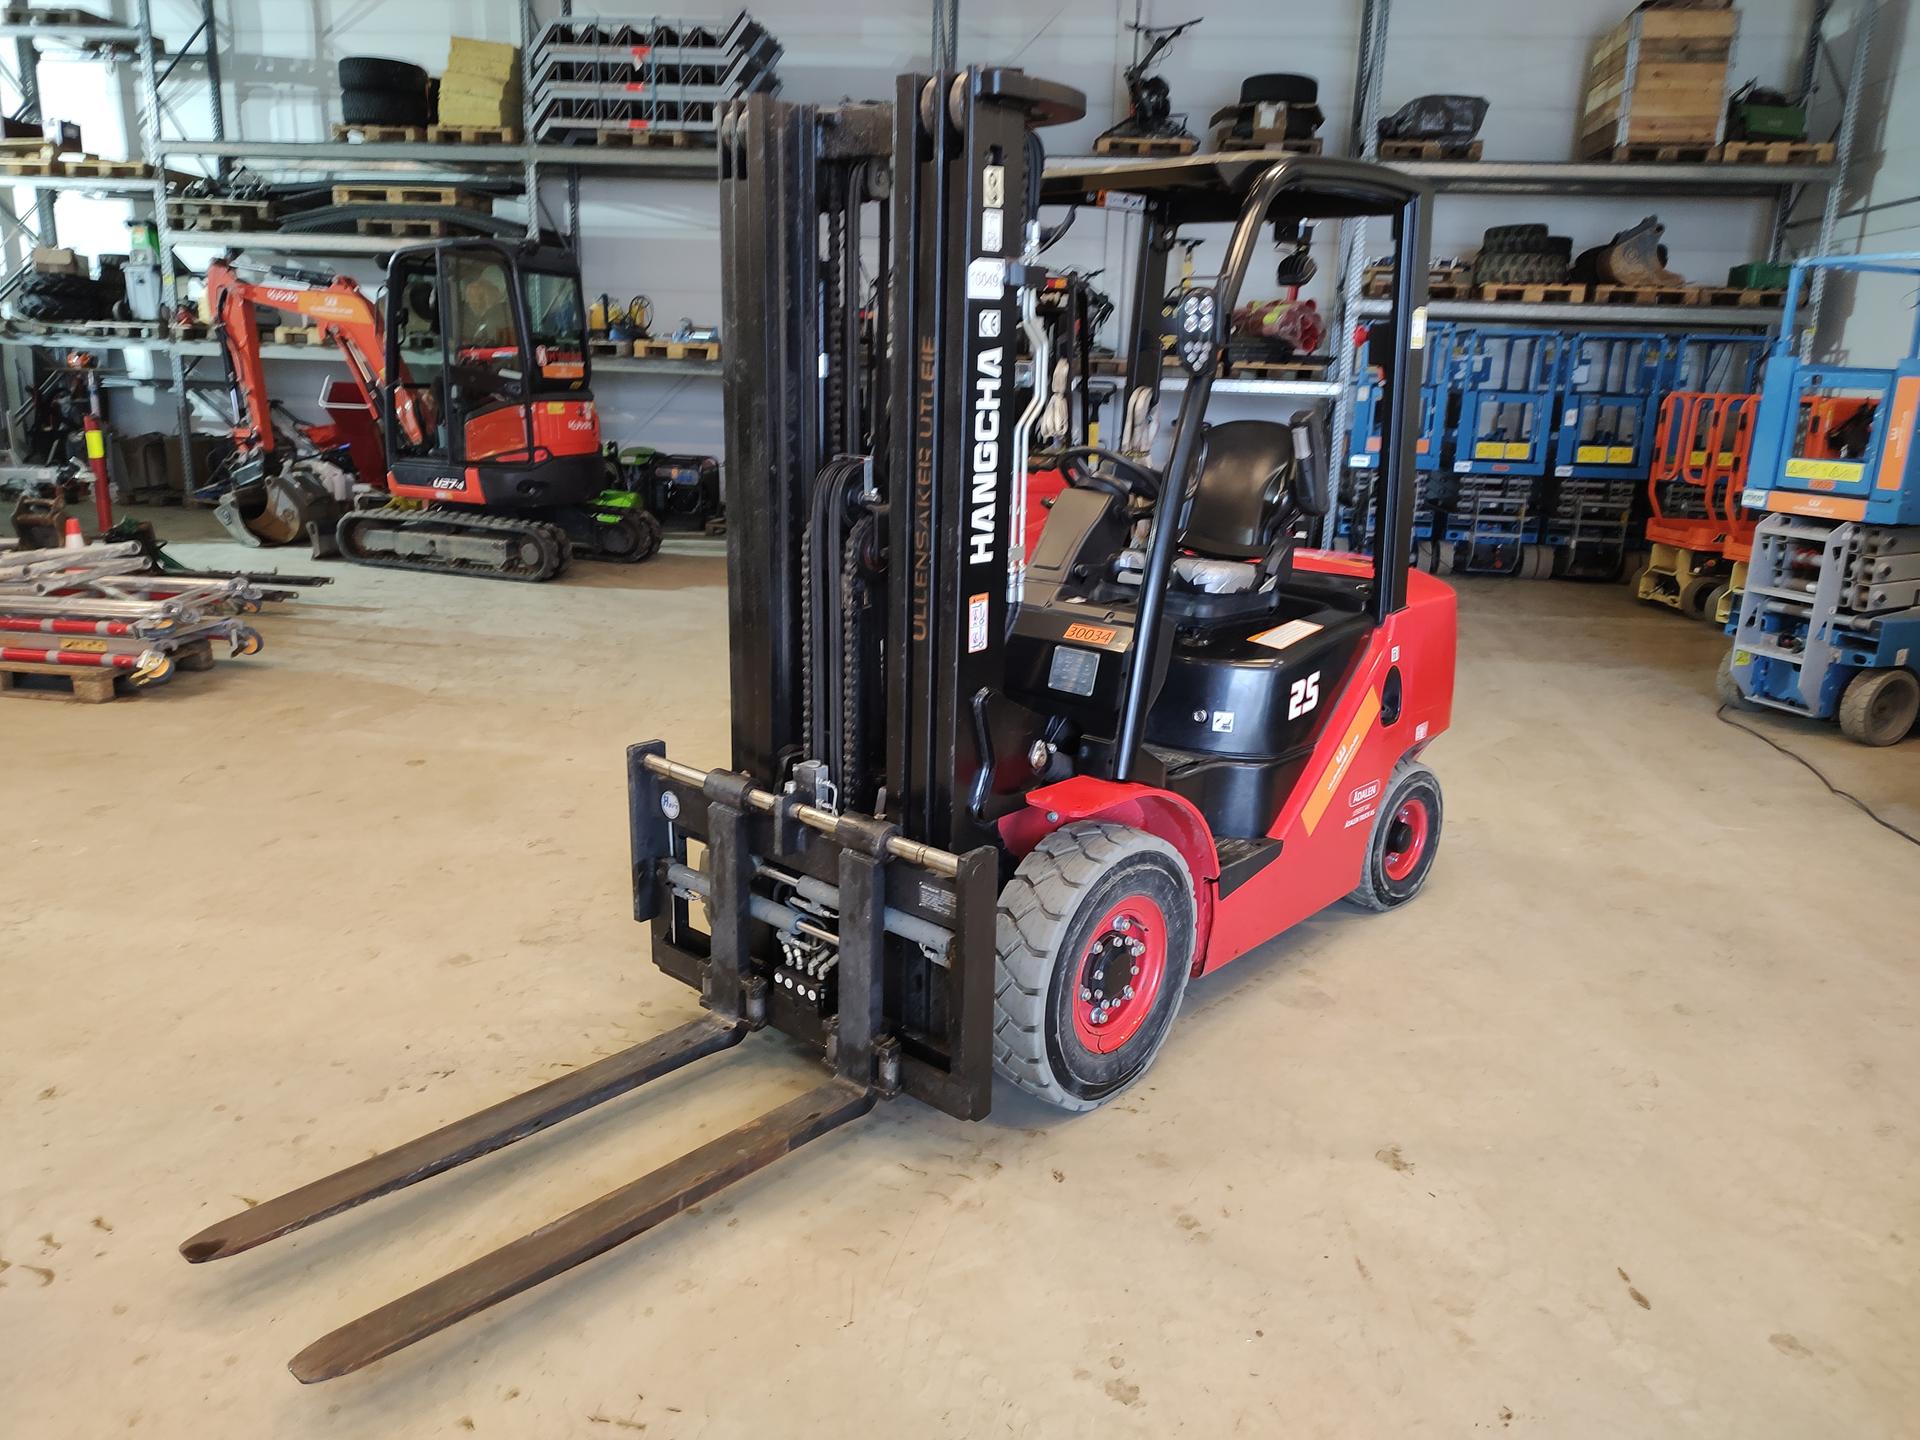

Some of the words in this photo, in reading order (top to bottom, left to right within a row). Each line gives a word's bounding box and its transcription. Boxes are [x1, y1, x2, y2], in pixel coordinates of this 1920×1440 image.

[919, 335, 936, 438] UTLEIE
[969, 346, 1003, 565] HANGCHA
[913, 447, 933, 641] ULLENSAKER
[1066, 626, 1112, 642] 30034
[1288, 670, 1320, 721] 25
